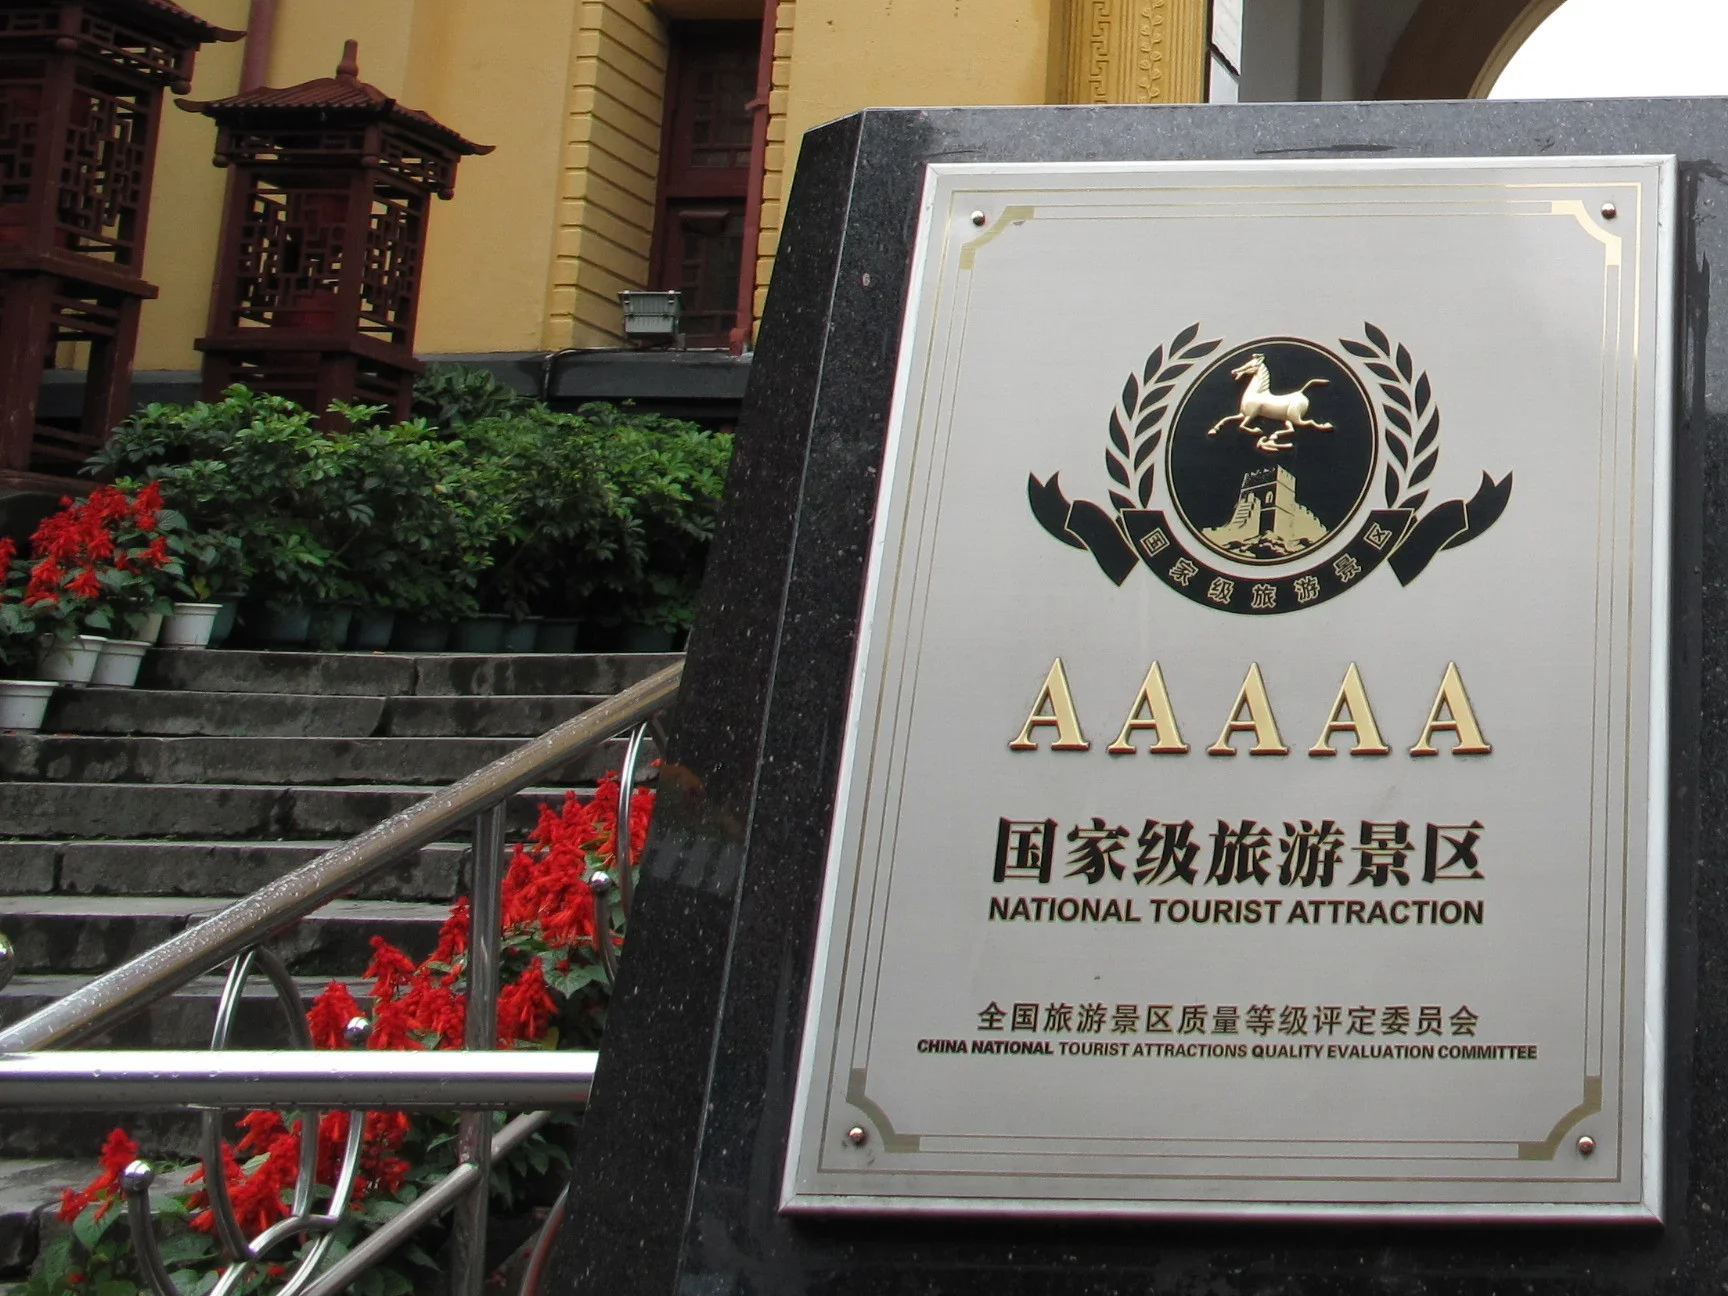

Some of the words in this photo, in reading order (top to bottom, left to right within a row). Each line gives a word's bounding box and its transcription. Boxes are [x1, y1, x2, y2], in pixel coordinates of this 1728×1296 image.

[1140, 522, 1392, 609] 国家级旅游景区
[992, 816, 1485, 888] 国家级旅游景区
[988, 896, 1142, 923] NATIONAL
[1150, 898, 1283, 924] TOURIST
[1286, 899, 1485, 925] ATTRACTION
[976, 1001, 1479, 1037] 全国旅游景区质量等级评定委员会
[916, 1038, 968, 1054] CHINA
[970, 1039, 1055, 1055] NATIONAL
[1058, 1041, 1130, 1056] TOURIST
[1132, 1042, 1248, 1058] ATTRACTIONS
[1251, 1044, 1324, 1059] QUALITY
[1326, 1044, 1435, 1059] EVALUATION
[1437, 1044, 1538, 1060] COMMITTEE
